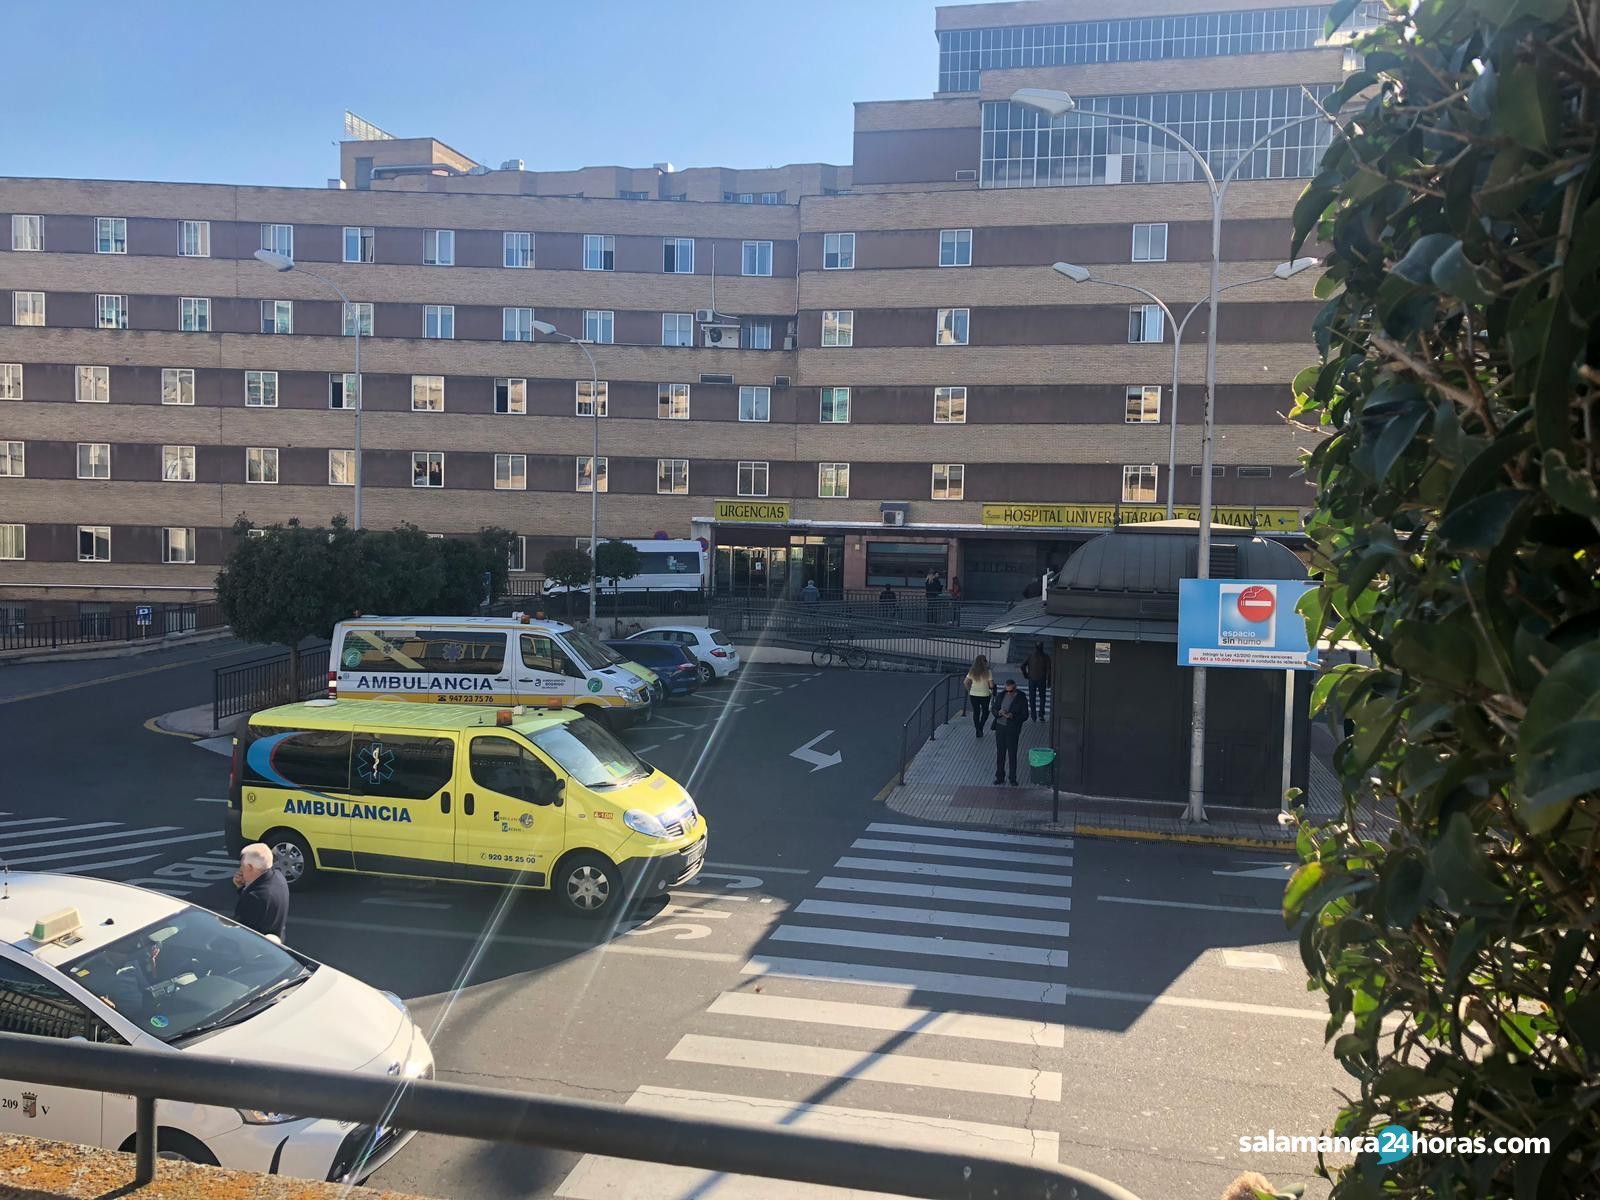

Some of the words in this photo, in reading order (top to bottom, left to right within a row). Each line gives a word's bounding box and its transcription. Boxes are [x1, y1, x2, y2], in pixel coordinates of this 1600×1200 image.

[720, 505, 784, 518] URGENCIAS
[1004, 509, 1063, 523] HOSPITAL
[1066, 511, 1163, 525] UNIVERITARIO
[1188, 512, 1272, 527] SMANCA
[1222, 636, 1235, 645] sin
[1237, 637, 1262, 645] humo
[357, 675, 493, 691] AMBULANCIA
[449, 694, 463, 702] 947
[475, 695, 484, 703] 75
[485, 695, 494, 703] 76
[284, 799, 412, 823] AMBULANCIA
[488, 853, 502, 861] 920
[526, 856, 536, 864] 00
[2, 1098, 19, 1109] 209
[41, 1105, 50, 1115] V
